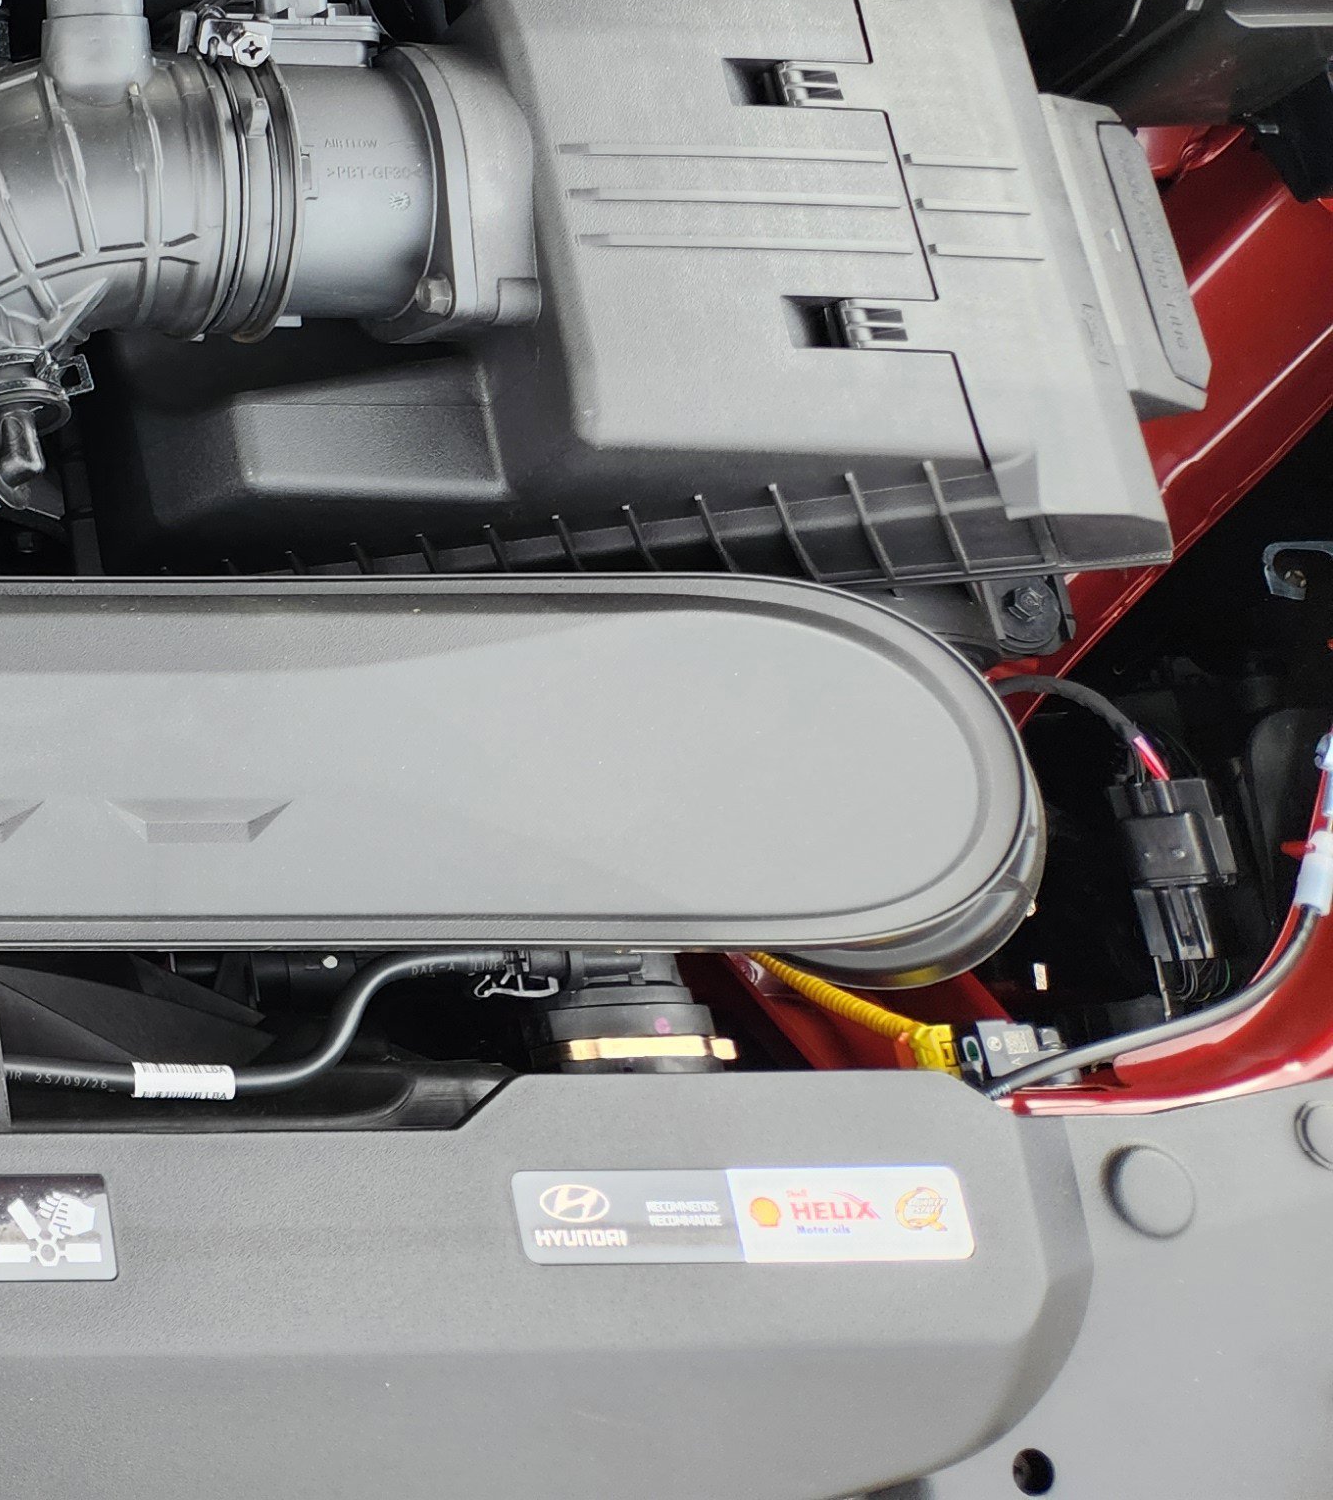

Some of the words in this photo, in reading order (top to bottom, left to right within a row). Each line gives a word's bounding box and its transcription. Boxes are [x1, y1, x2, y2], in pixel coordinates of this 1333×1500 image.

[791, 1201, 875, 1221] HELIX
[535, 1229, 628, 1248] HYUNDAI
[796, 1225, 830, 1235] Motor
[833, 1225, 851, 1235] oils
